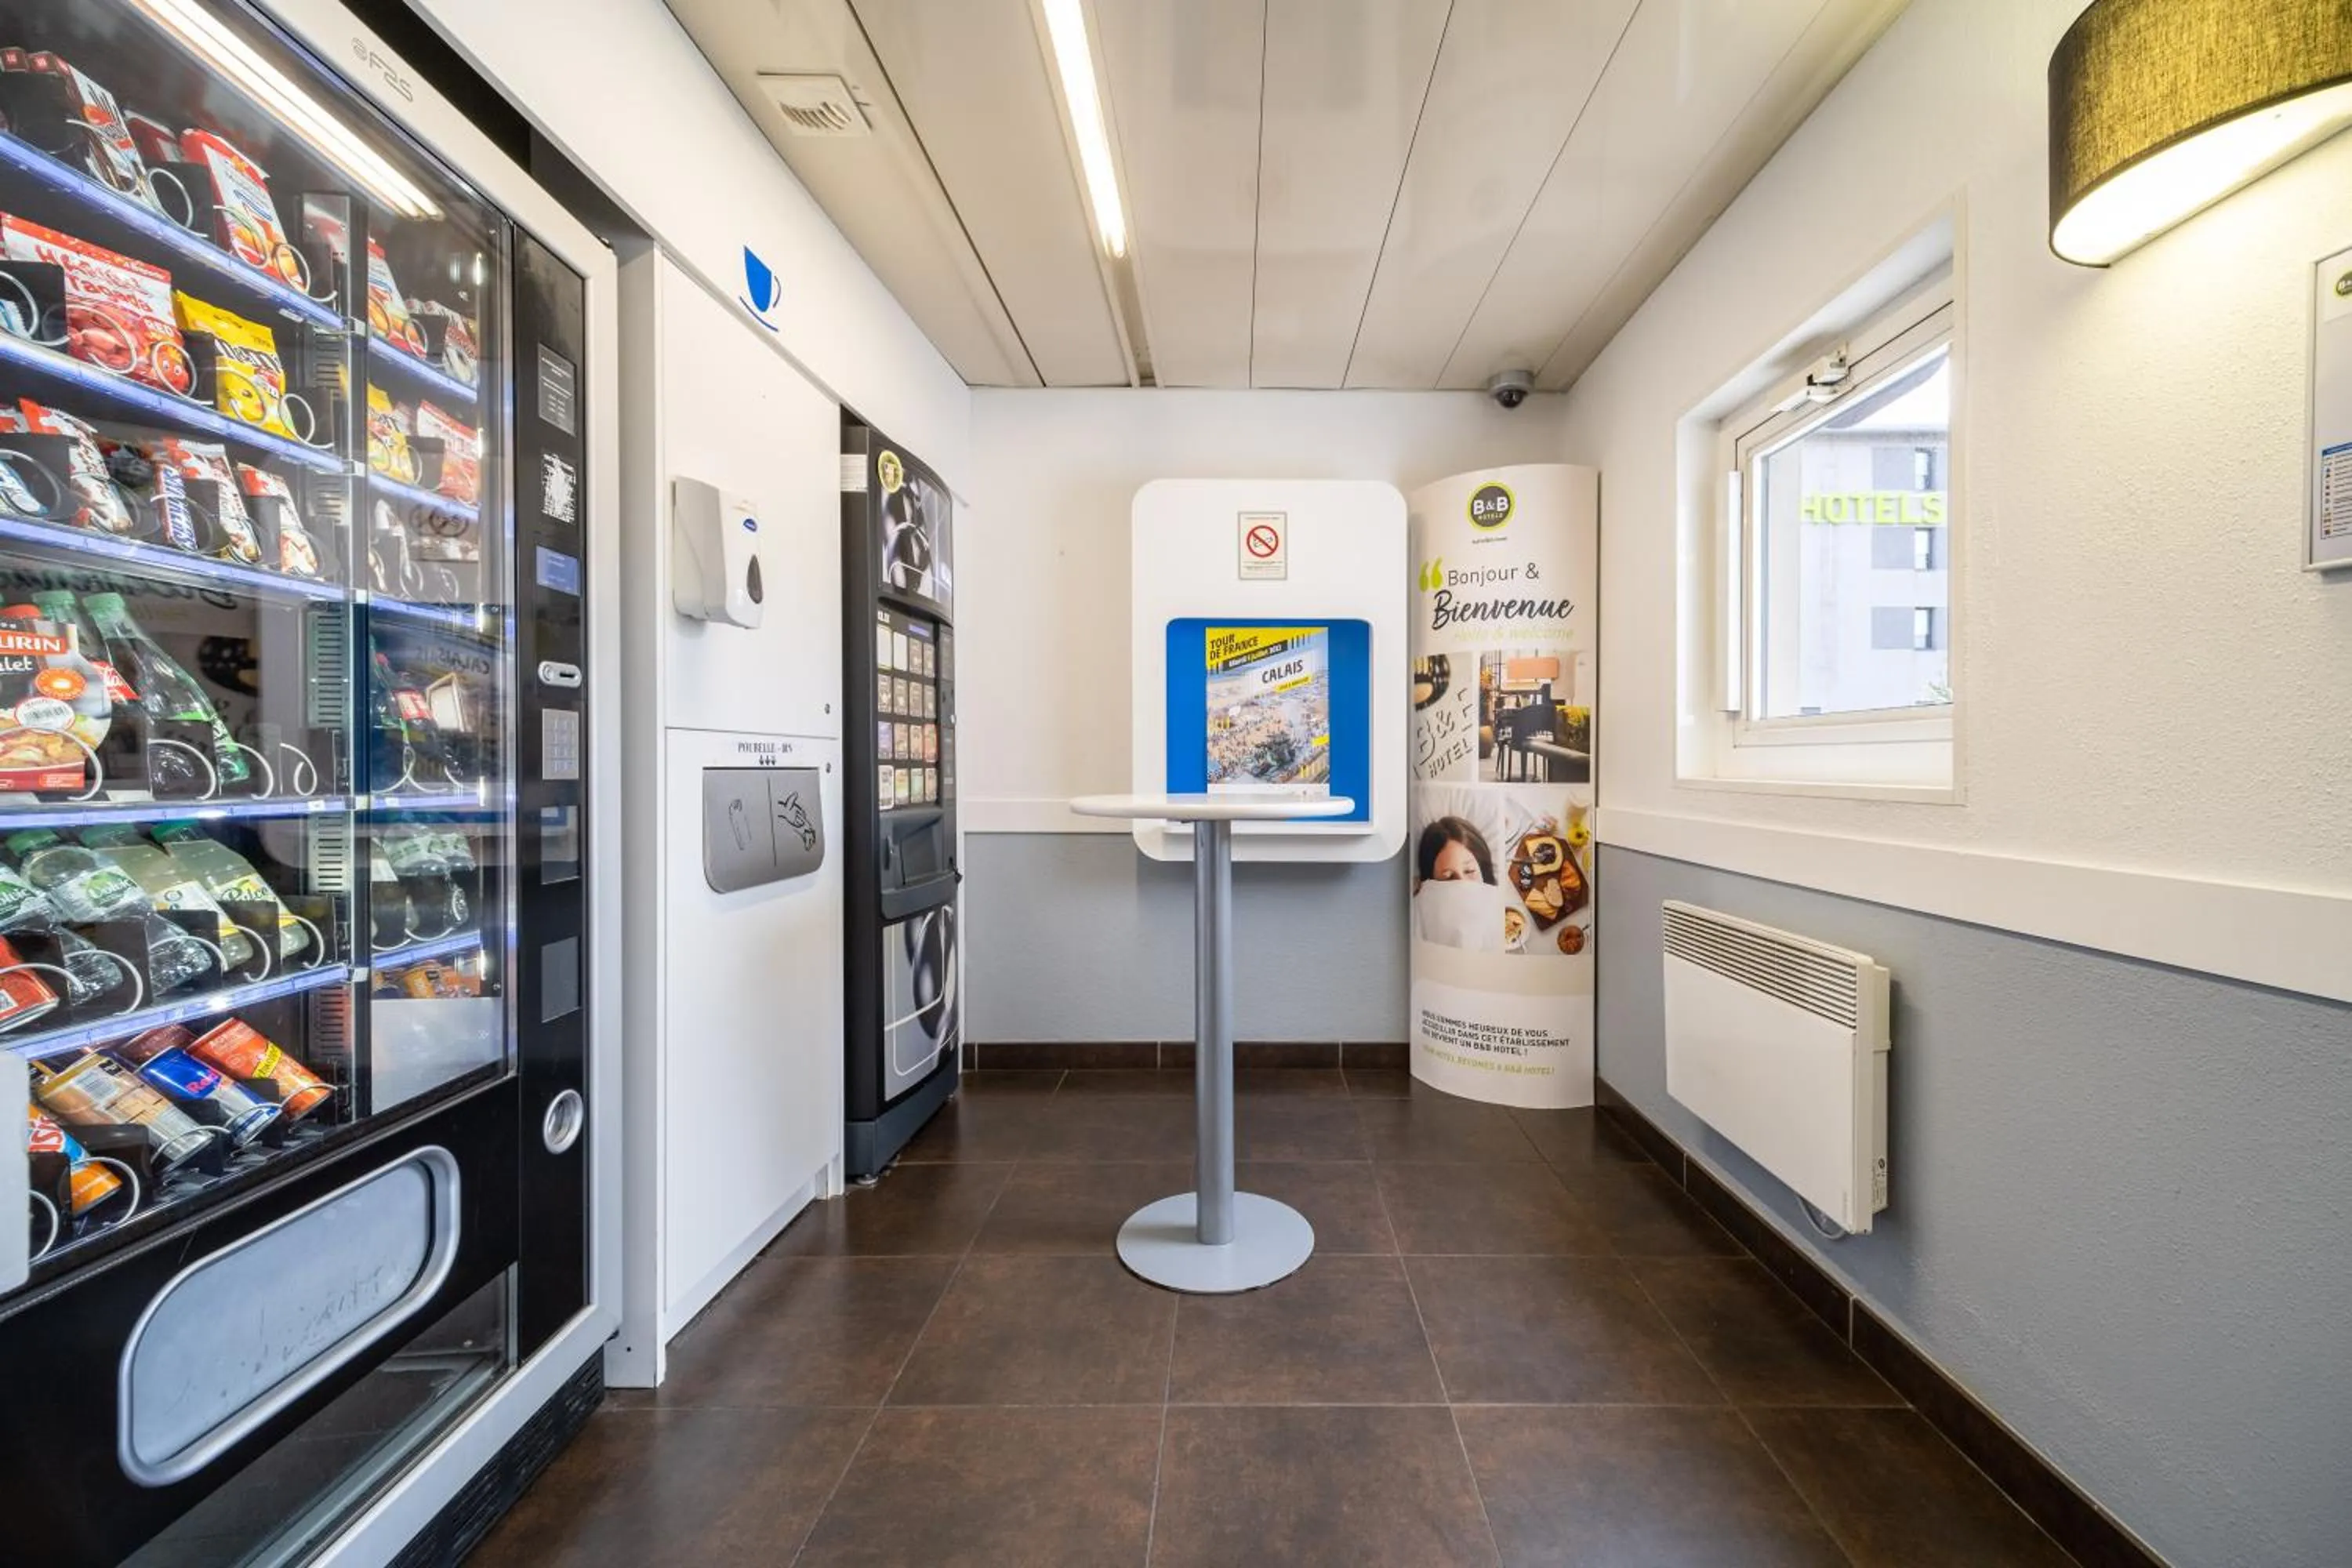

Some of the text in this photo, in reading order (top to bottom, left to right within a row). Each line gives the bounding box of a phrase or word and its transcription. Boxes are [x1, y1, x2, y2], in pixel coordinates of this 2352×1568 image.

[1473, 496, 1509, 515] B&B
[1800, 491, 1943, 525] HOTELS
[1448, 562, 1540, 587] Bonjour &
[1432, 589, 1575, 630] Bienvenue
[1210, 633, 1236, 650] TOUR
[1210, 650, 1221, 660] DE
[1224, 636, 1259, 655] FRANCE
[1261, 659, 1304, 684] CALAIS
[1468, 1022, 1508, 1036] HEUREUX
[1511, 1028, 1523, 1036] DE
[1524, 1029, 1549, 1038] VOUS
[1481, 1034, 1497, 1044] CET
[1459, 1040, 1472, 1048] UN
